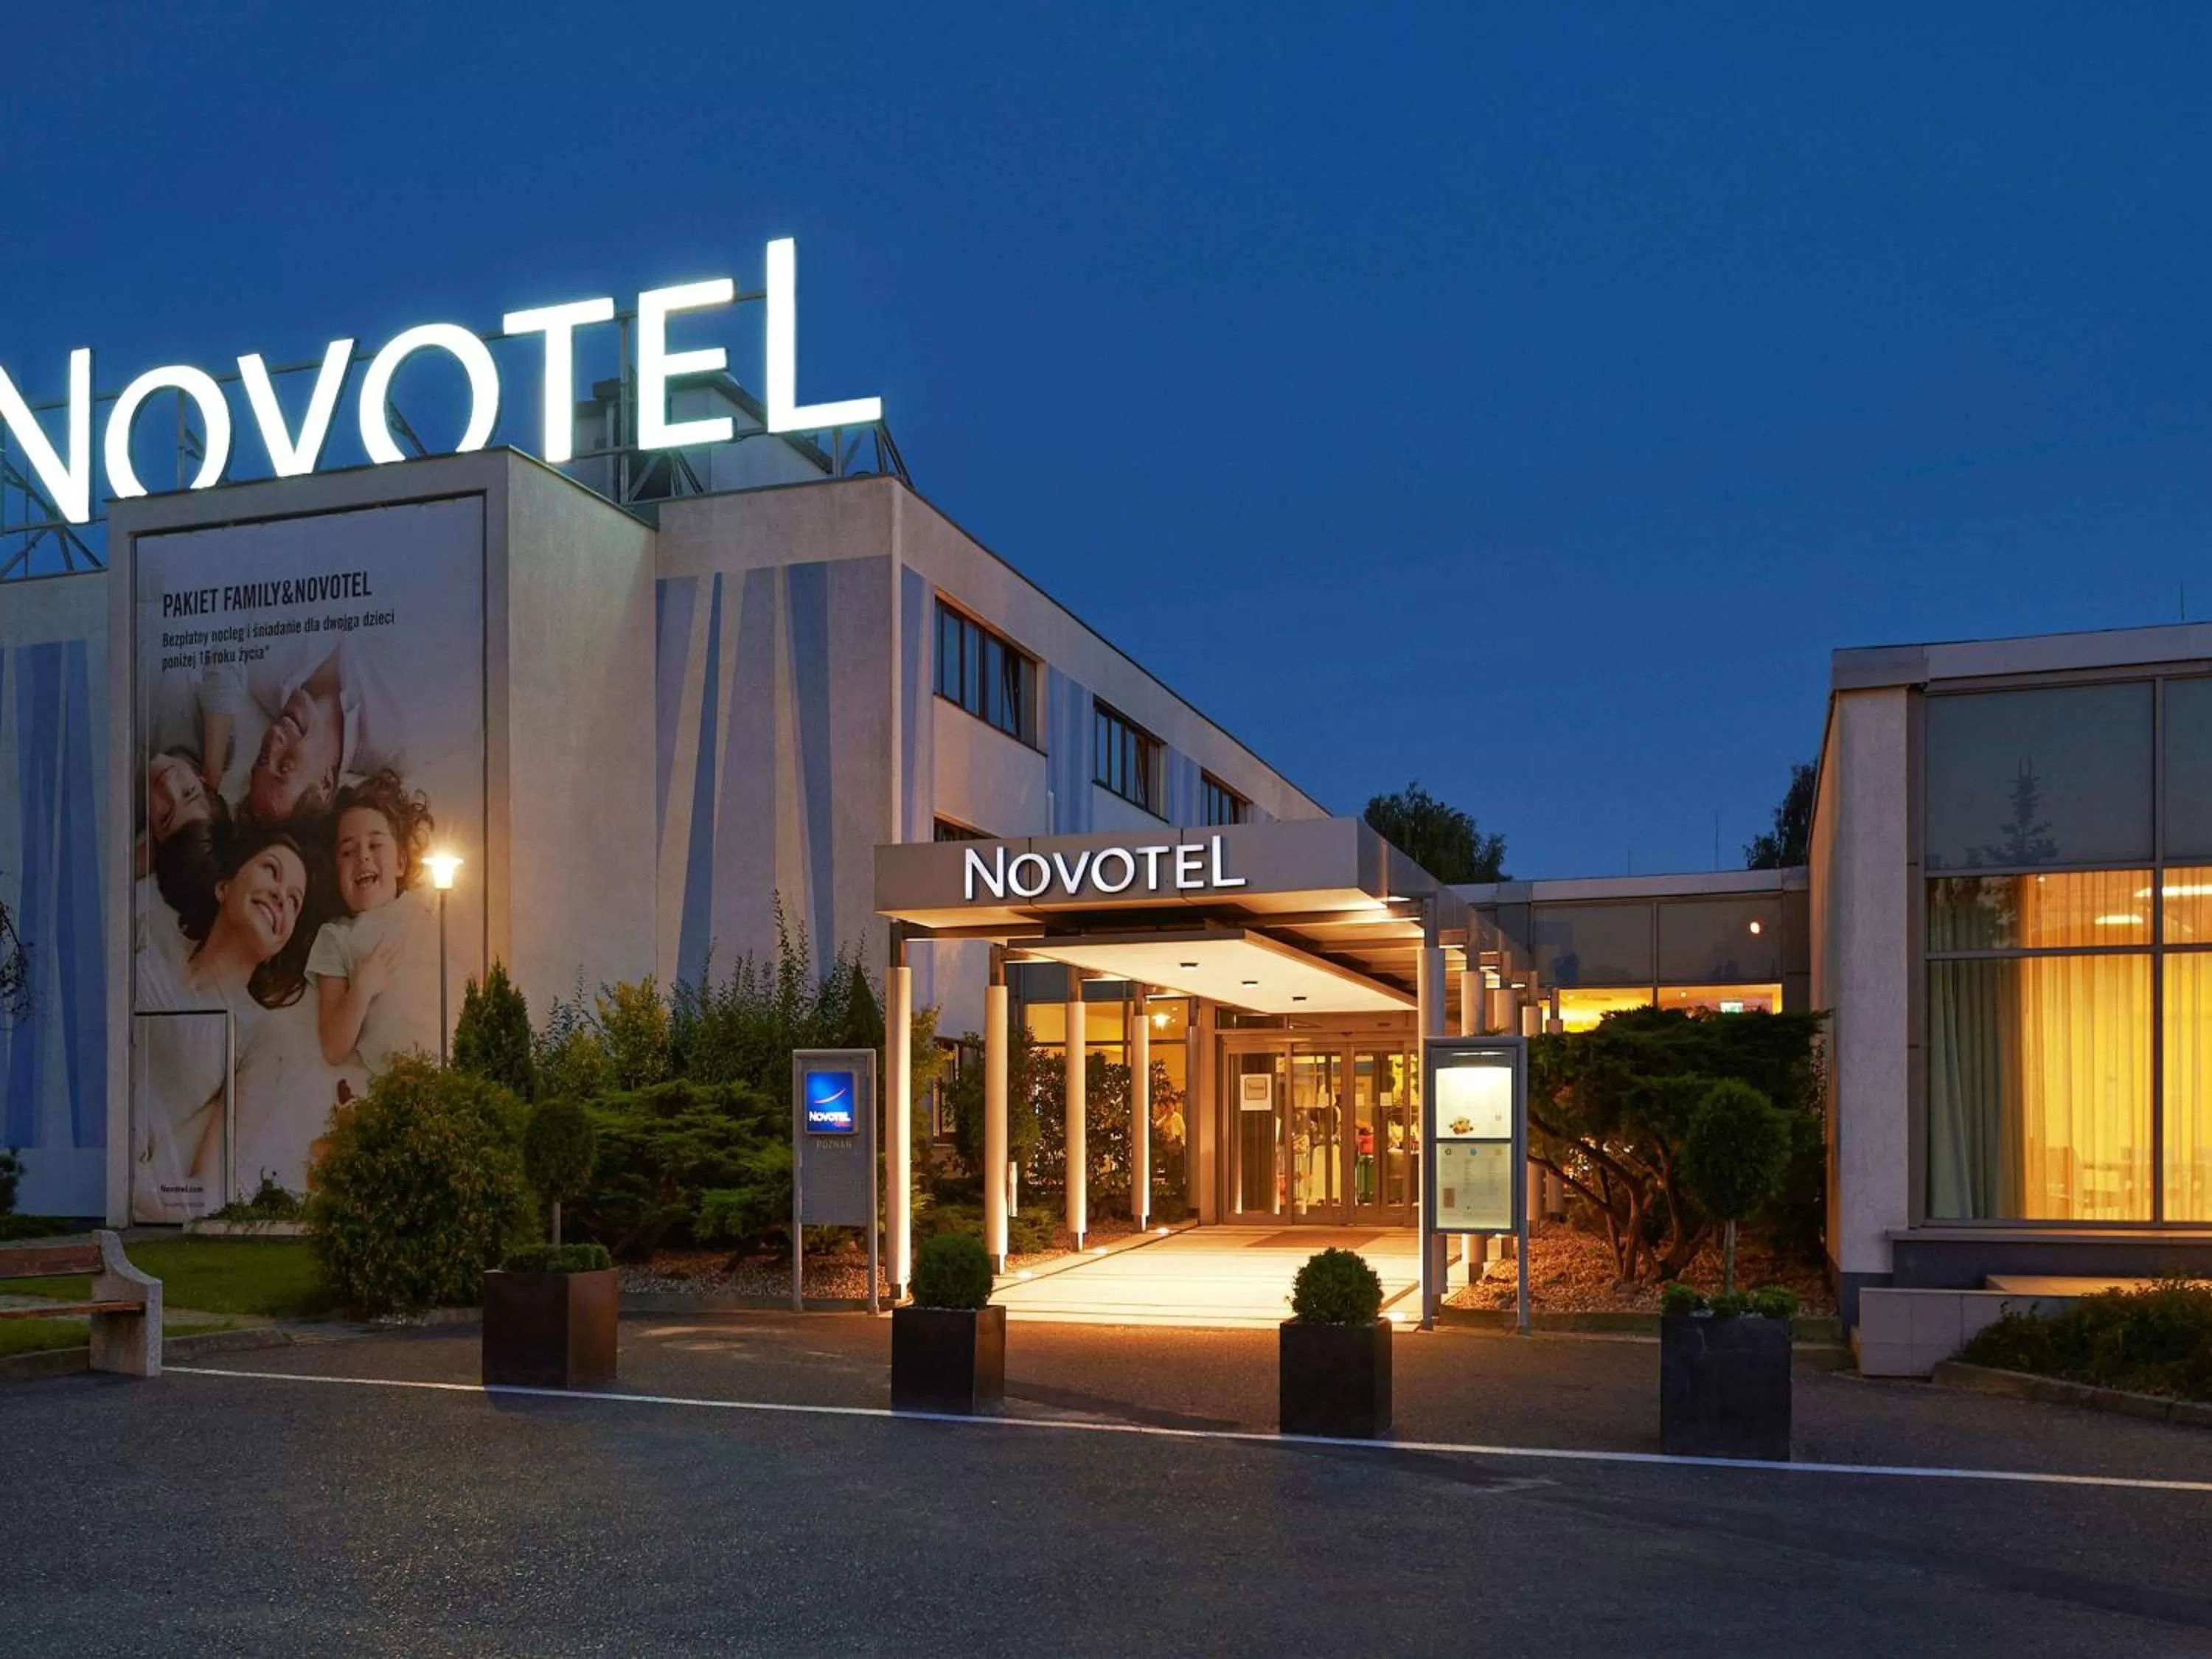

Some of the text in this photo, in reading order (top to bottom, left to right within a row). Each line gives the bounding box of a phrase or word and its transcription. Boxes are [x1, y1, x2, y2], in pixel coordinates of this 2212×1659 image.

[0, 237, 883, 524] NOVOTEL
[163, 571, 372, 618] PAKIET FAMILY&NOVOTEL
[162, 608, 395, 649] Bezpłatny nocleg i śniadanie dla dwojga dzieci
[161, 650, 196, 672] poniżej
[213, 647, 235, 664] roku
[964, 835, 1246, 900] NOVOTEL
[809, 1110, 851, 1122] NOVOTEL
